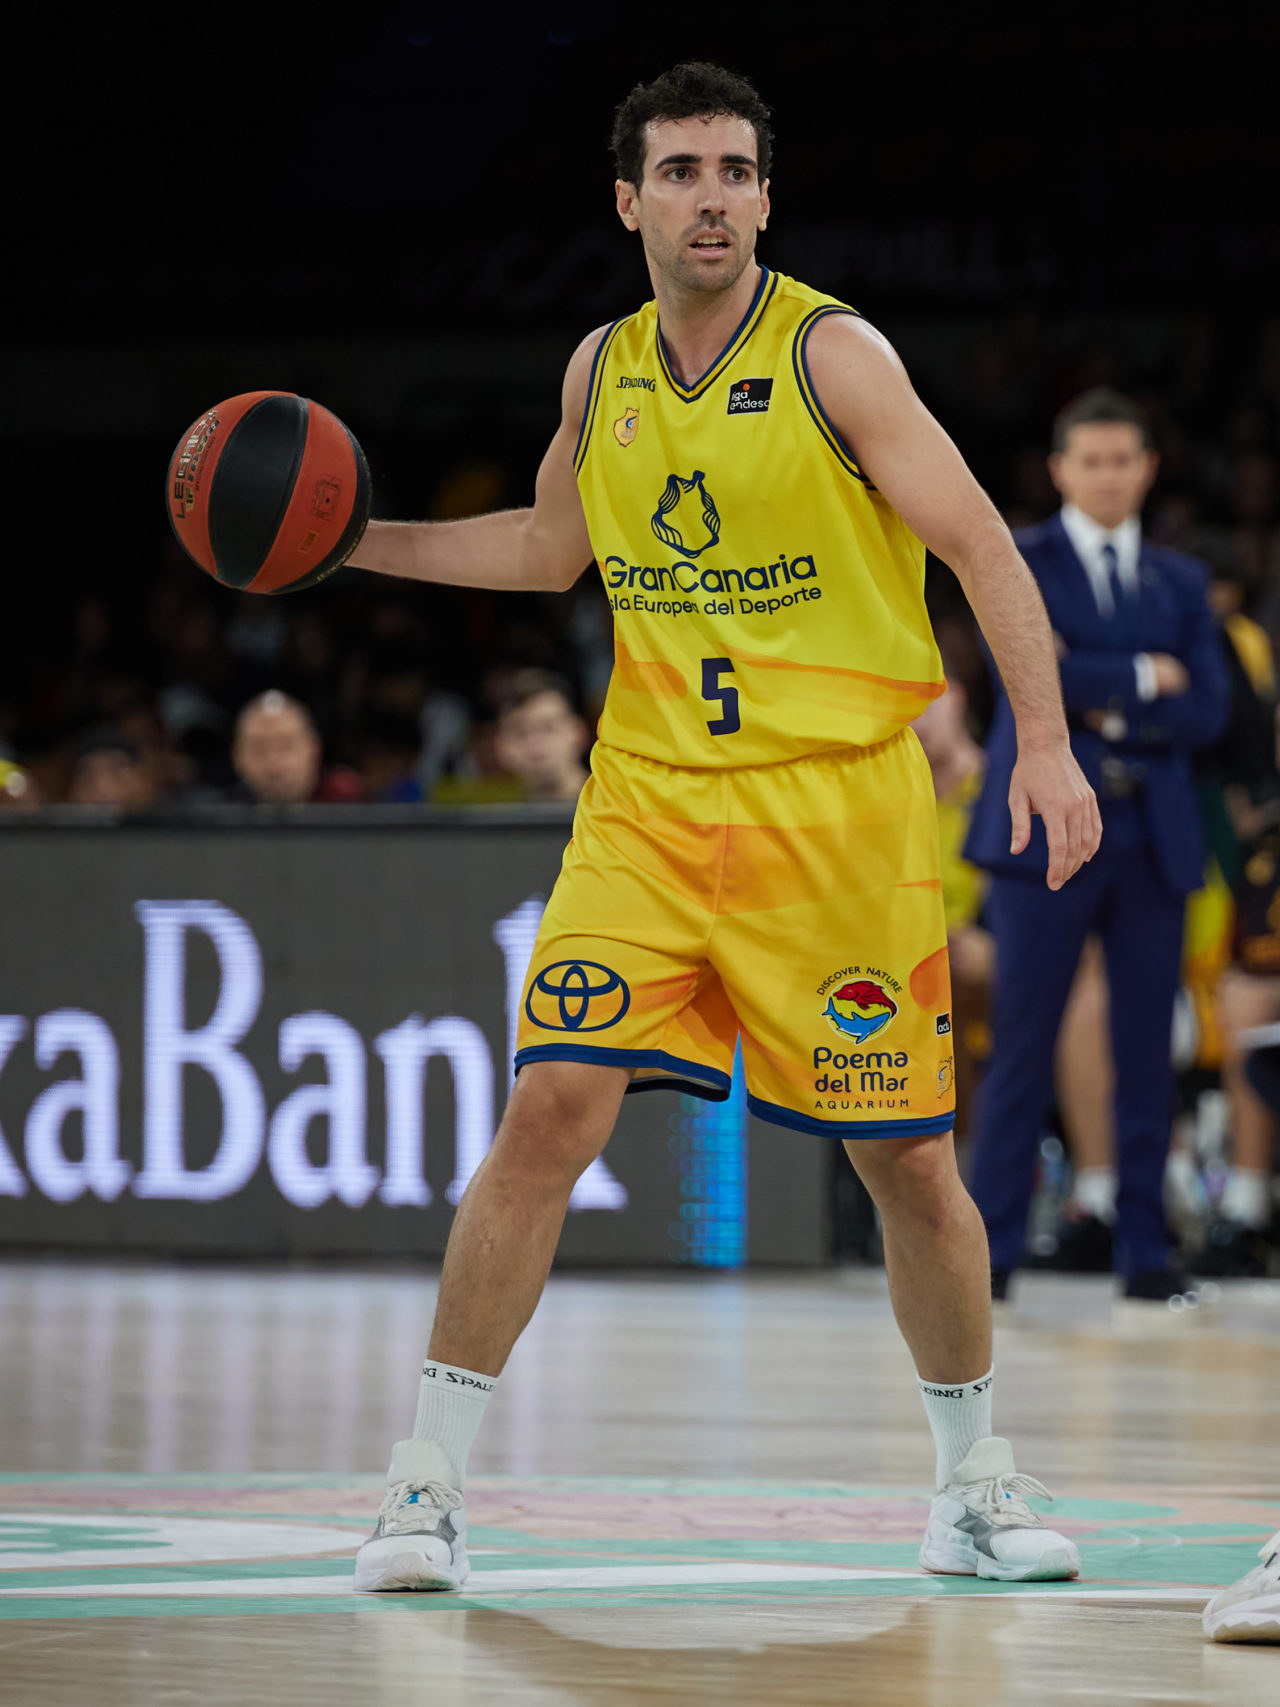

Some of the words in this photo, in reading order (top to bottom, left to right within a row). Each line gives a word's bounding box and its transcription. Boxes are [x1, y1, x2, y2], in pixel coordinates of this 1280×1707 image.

[609, 594, 631, 611] sla
[703, 599, 734, 615] del
[740, 584, 822, 615] Deporte
[701, 657, 741, 736] 5
[816, 966, 861, 996] DISCOVER
[866, 966, 903, 994] NATURE
[0, 894, 628, 1211] aBan
[813, 1046, 909, 1069] Poema
[814, 1073, 851, 1093] del
[860, 1071, 909, 1092] Mar
[814, 1099, 909, 1110] AQUARIUM
